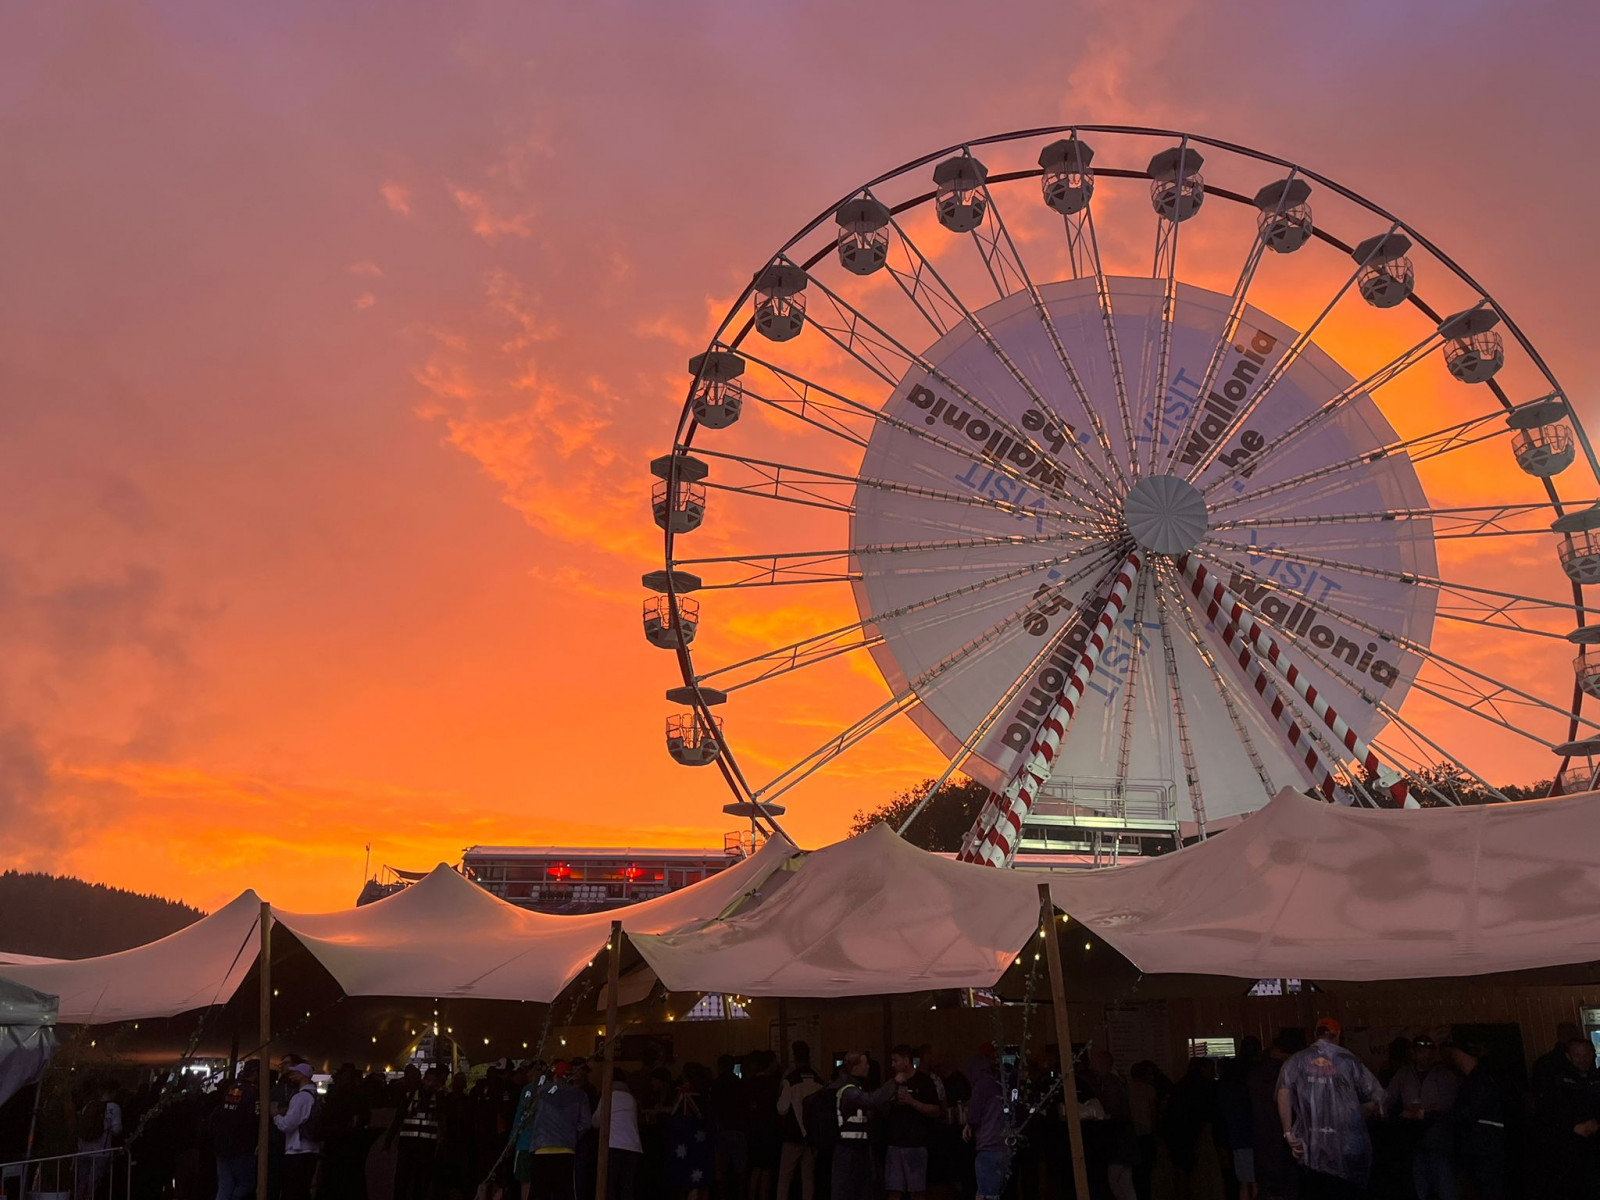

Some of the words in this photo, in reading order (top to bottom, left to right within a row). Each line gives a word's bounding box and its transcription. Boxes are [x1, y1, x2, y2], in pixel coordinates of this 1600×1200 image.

[906, 383, 1071, 501] wallonia
[1134, 368, 1201, 447] VISIT
[1167, 330, 1277, 470] wallonia
[955, 463, 1046, 532] VISIT
[1250, 529, 1342, 603] VISIT
[1087, 618, 1161, 705] VISIT
[1229, 561, 1400, 689] wallonia
